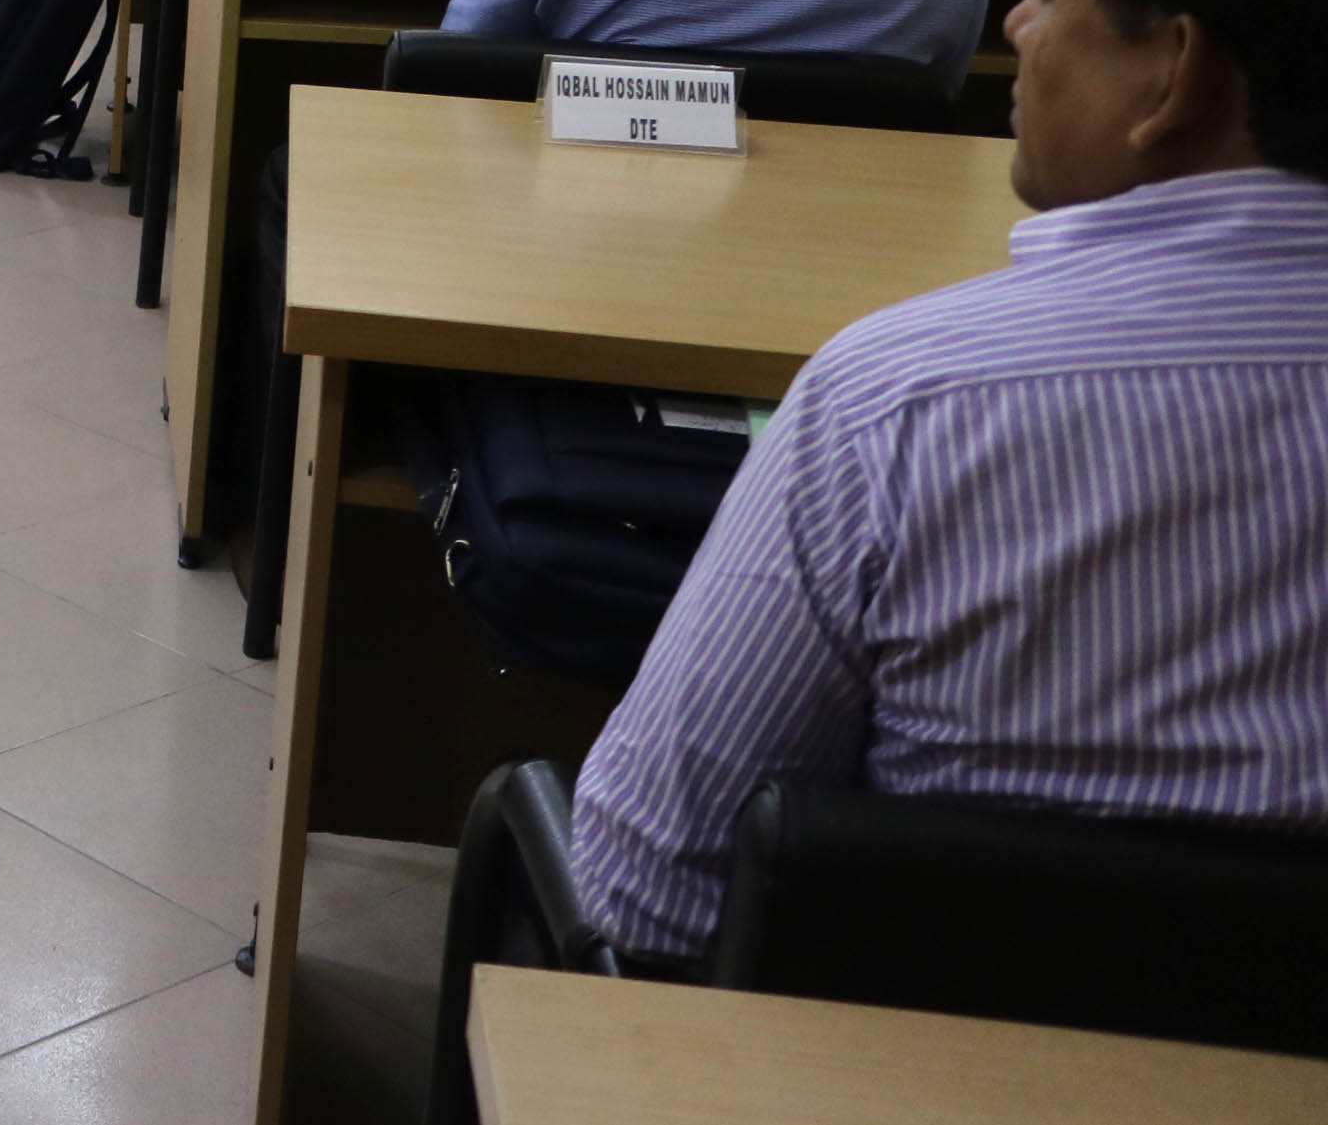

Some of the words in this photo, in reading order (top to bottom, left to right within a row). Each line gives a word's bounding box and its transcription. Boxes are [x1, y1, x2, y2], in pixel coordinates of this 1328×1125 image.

[557, 74, 600, 98] IQBAL
[605, 77, 669, 101] HOSSAIN
[675, 80, 730, 104] MAMUN
[630, 118, 658, 141] DTE
